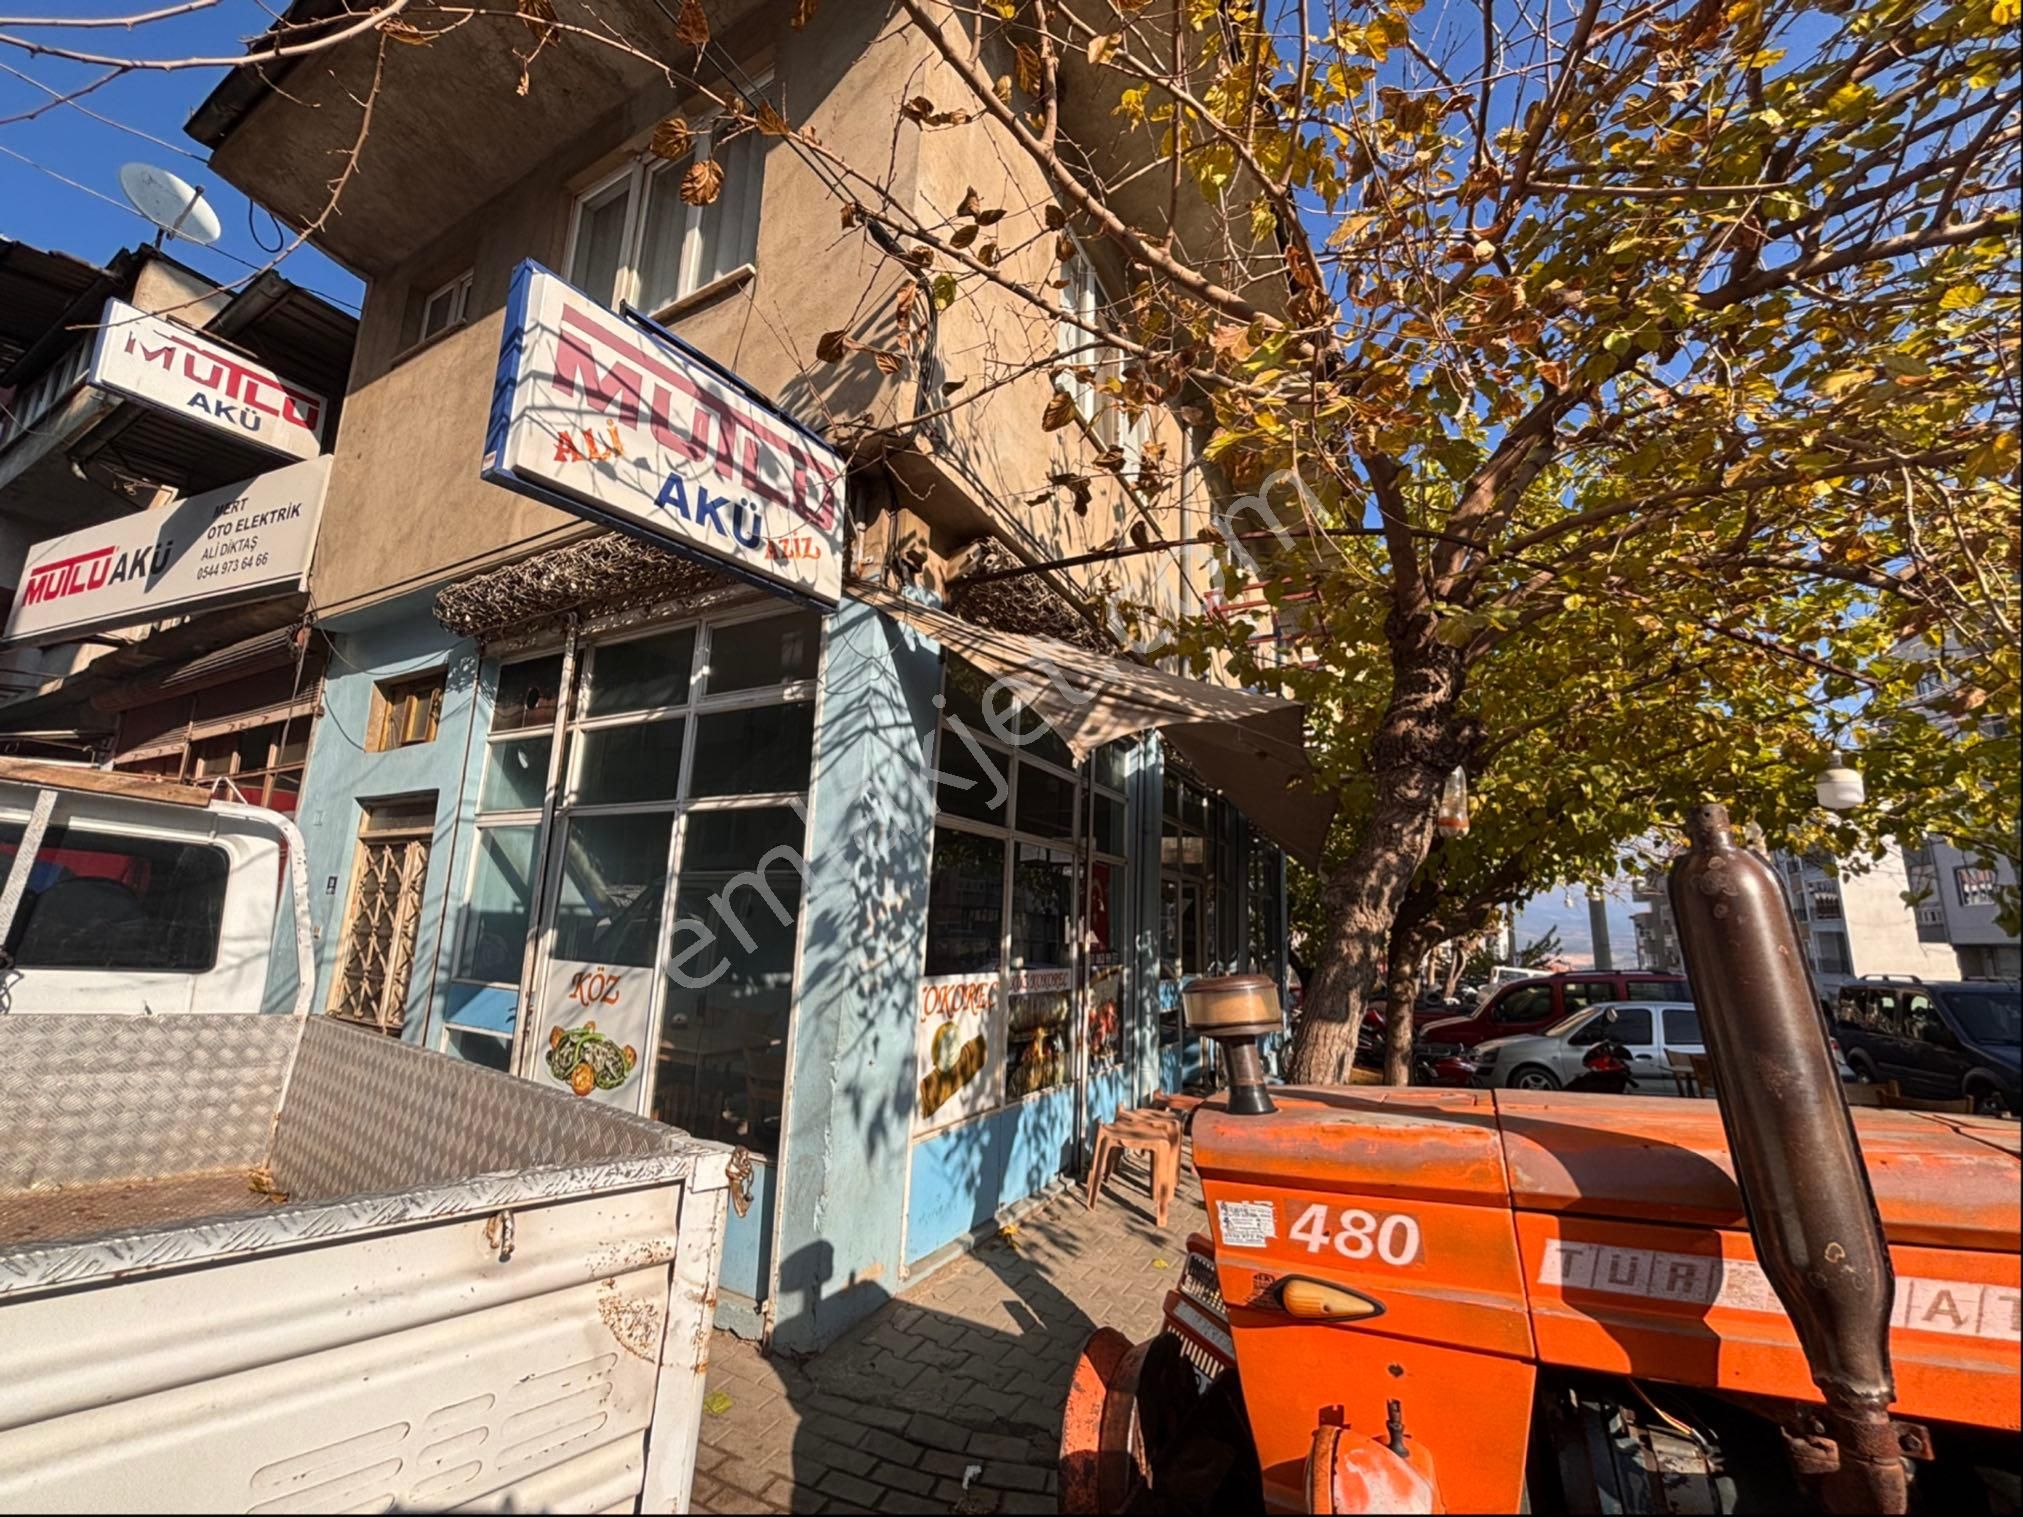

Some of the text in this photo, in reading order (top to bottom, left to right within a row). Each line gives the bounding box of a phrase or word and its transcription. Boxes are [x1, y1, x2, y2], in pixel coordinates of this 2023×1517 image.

[124, 330, 321, 431] MUTLU
[187, 391, 261, 432] AKÜ
[551, 303, 836, 531] MUTLU
[553, 418, 625, 463] ALİ
[207, 502, 302, 540] OTO ELEKTRİK
[653, 471, 763, 550] AKÜ
[196, 551, 269, 580] 0544 973 64 66
[201, 542, 219, 560] ALİ
[764, 531, 822, 561] AZİZ
[569, 966, 621, 1008] KÖZ
[1289, 1203, 1421, 1266] 480
